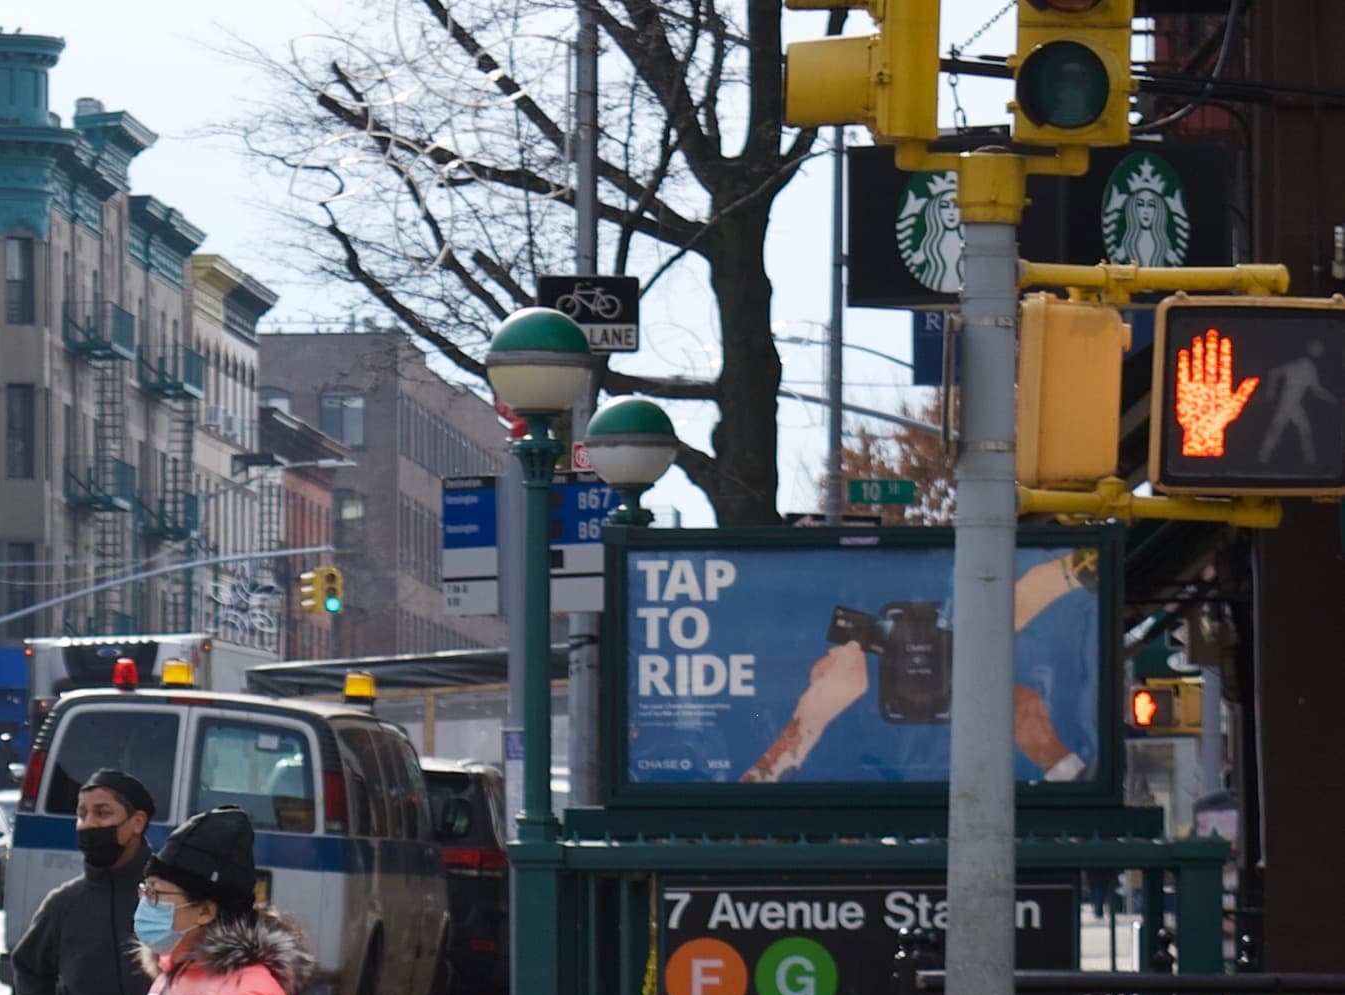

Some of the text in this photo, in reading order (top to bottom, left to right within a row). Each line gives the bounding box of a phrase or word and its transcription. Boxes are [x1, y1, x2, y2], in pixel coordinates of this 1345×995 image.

[925, 312, 941, 331] R
[590, 328, 634, 346] LANE
[577, 488, 612, 510] B67
[862, 482, 881, 500] 10
[637, 559, 736, 602] TAP
[637, 606, 710, 649] TO
[638, 654, 755, 697] RIDE
[637, 760, 677, 770] CHASE
[706, 760, 731, 769] VISA
[664, 891, 1041, 930] 7 Avenue Stan
